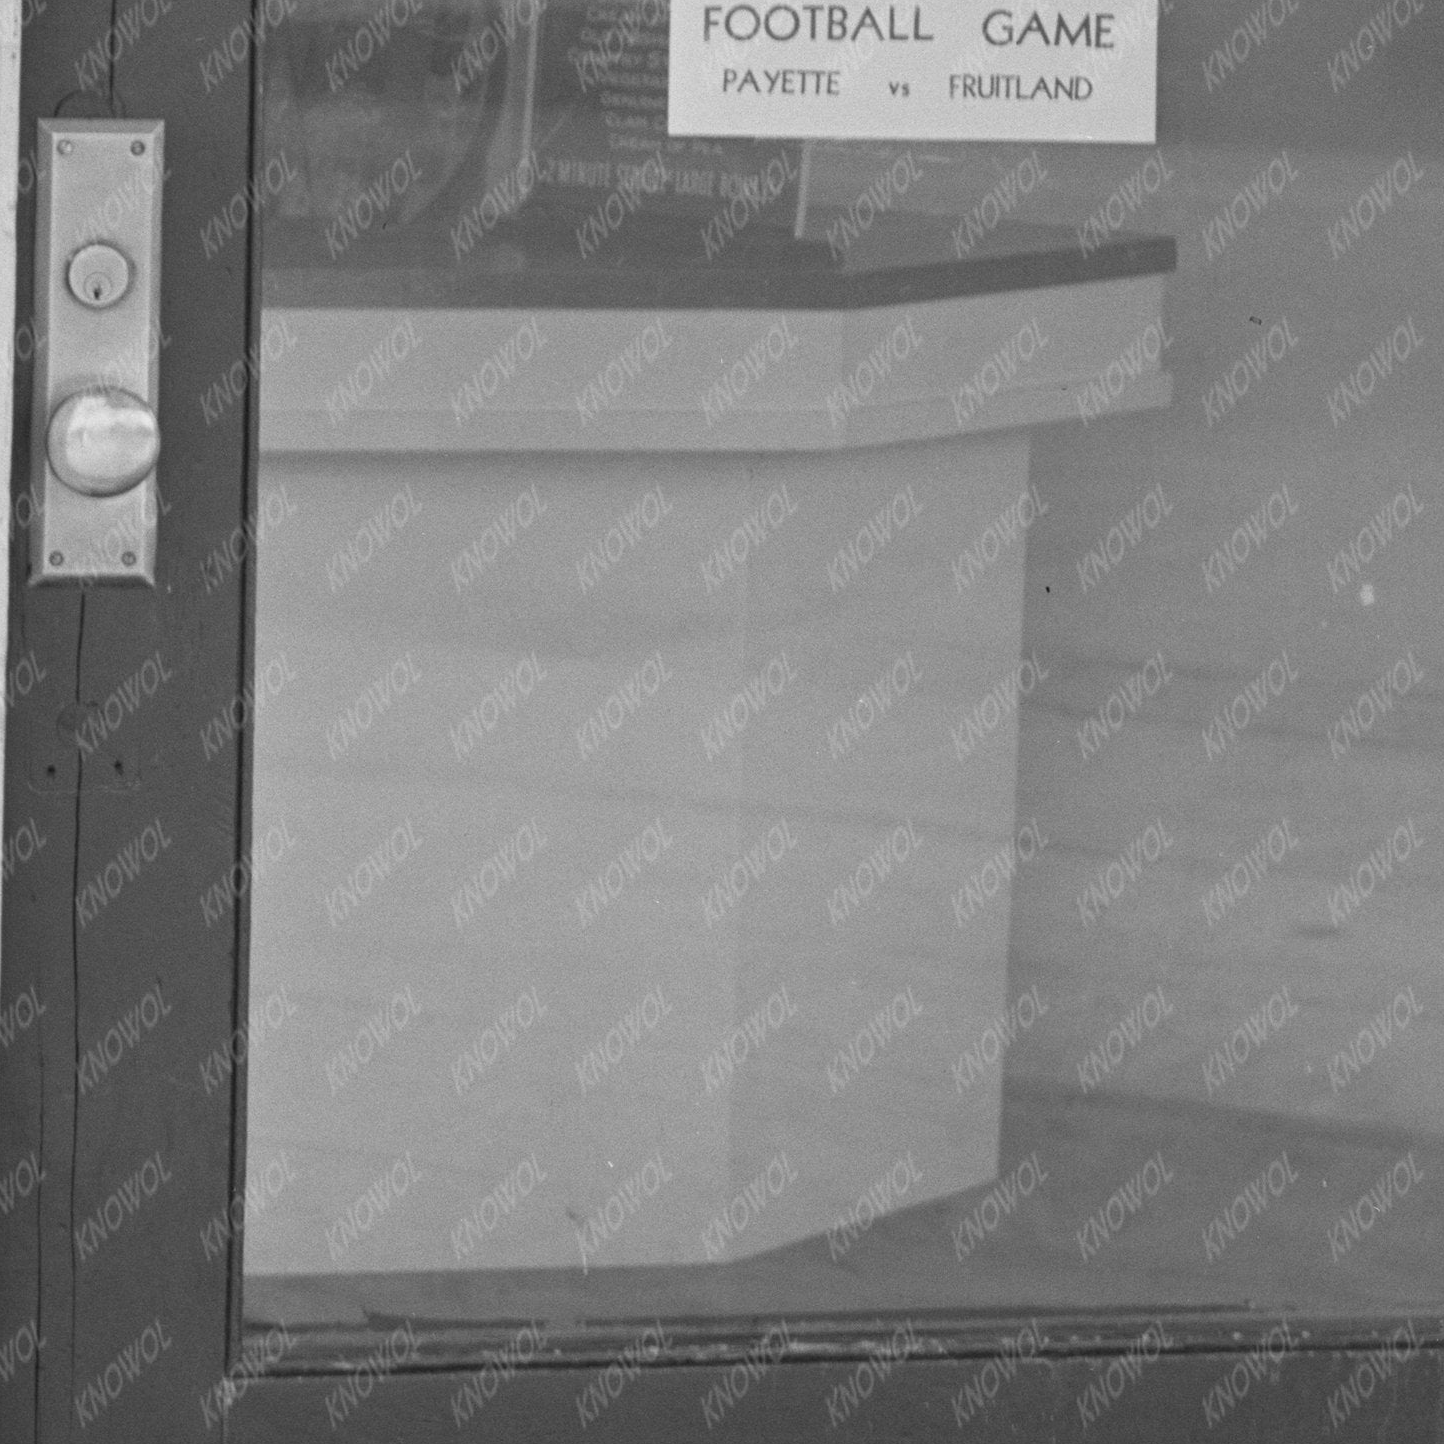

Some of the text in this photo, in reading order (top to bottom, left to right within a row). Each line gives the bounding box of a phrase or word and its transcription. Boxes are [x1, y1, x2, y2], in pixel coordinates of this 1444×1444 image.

[704, 5, 933, 42] FOOTBALL
[982, 9, 1114, 49] GAME
[723, 70, 1093, 100] PAYETTE vs FRUITLAND
